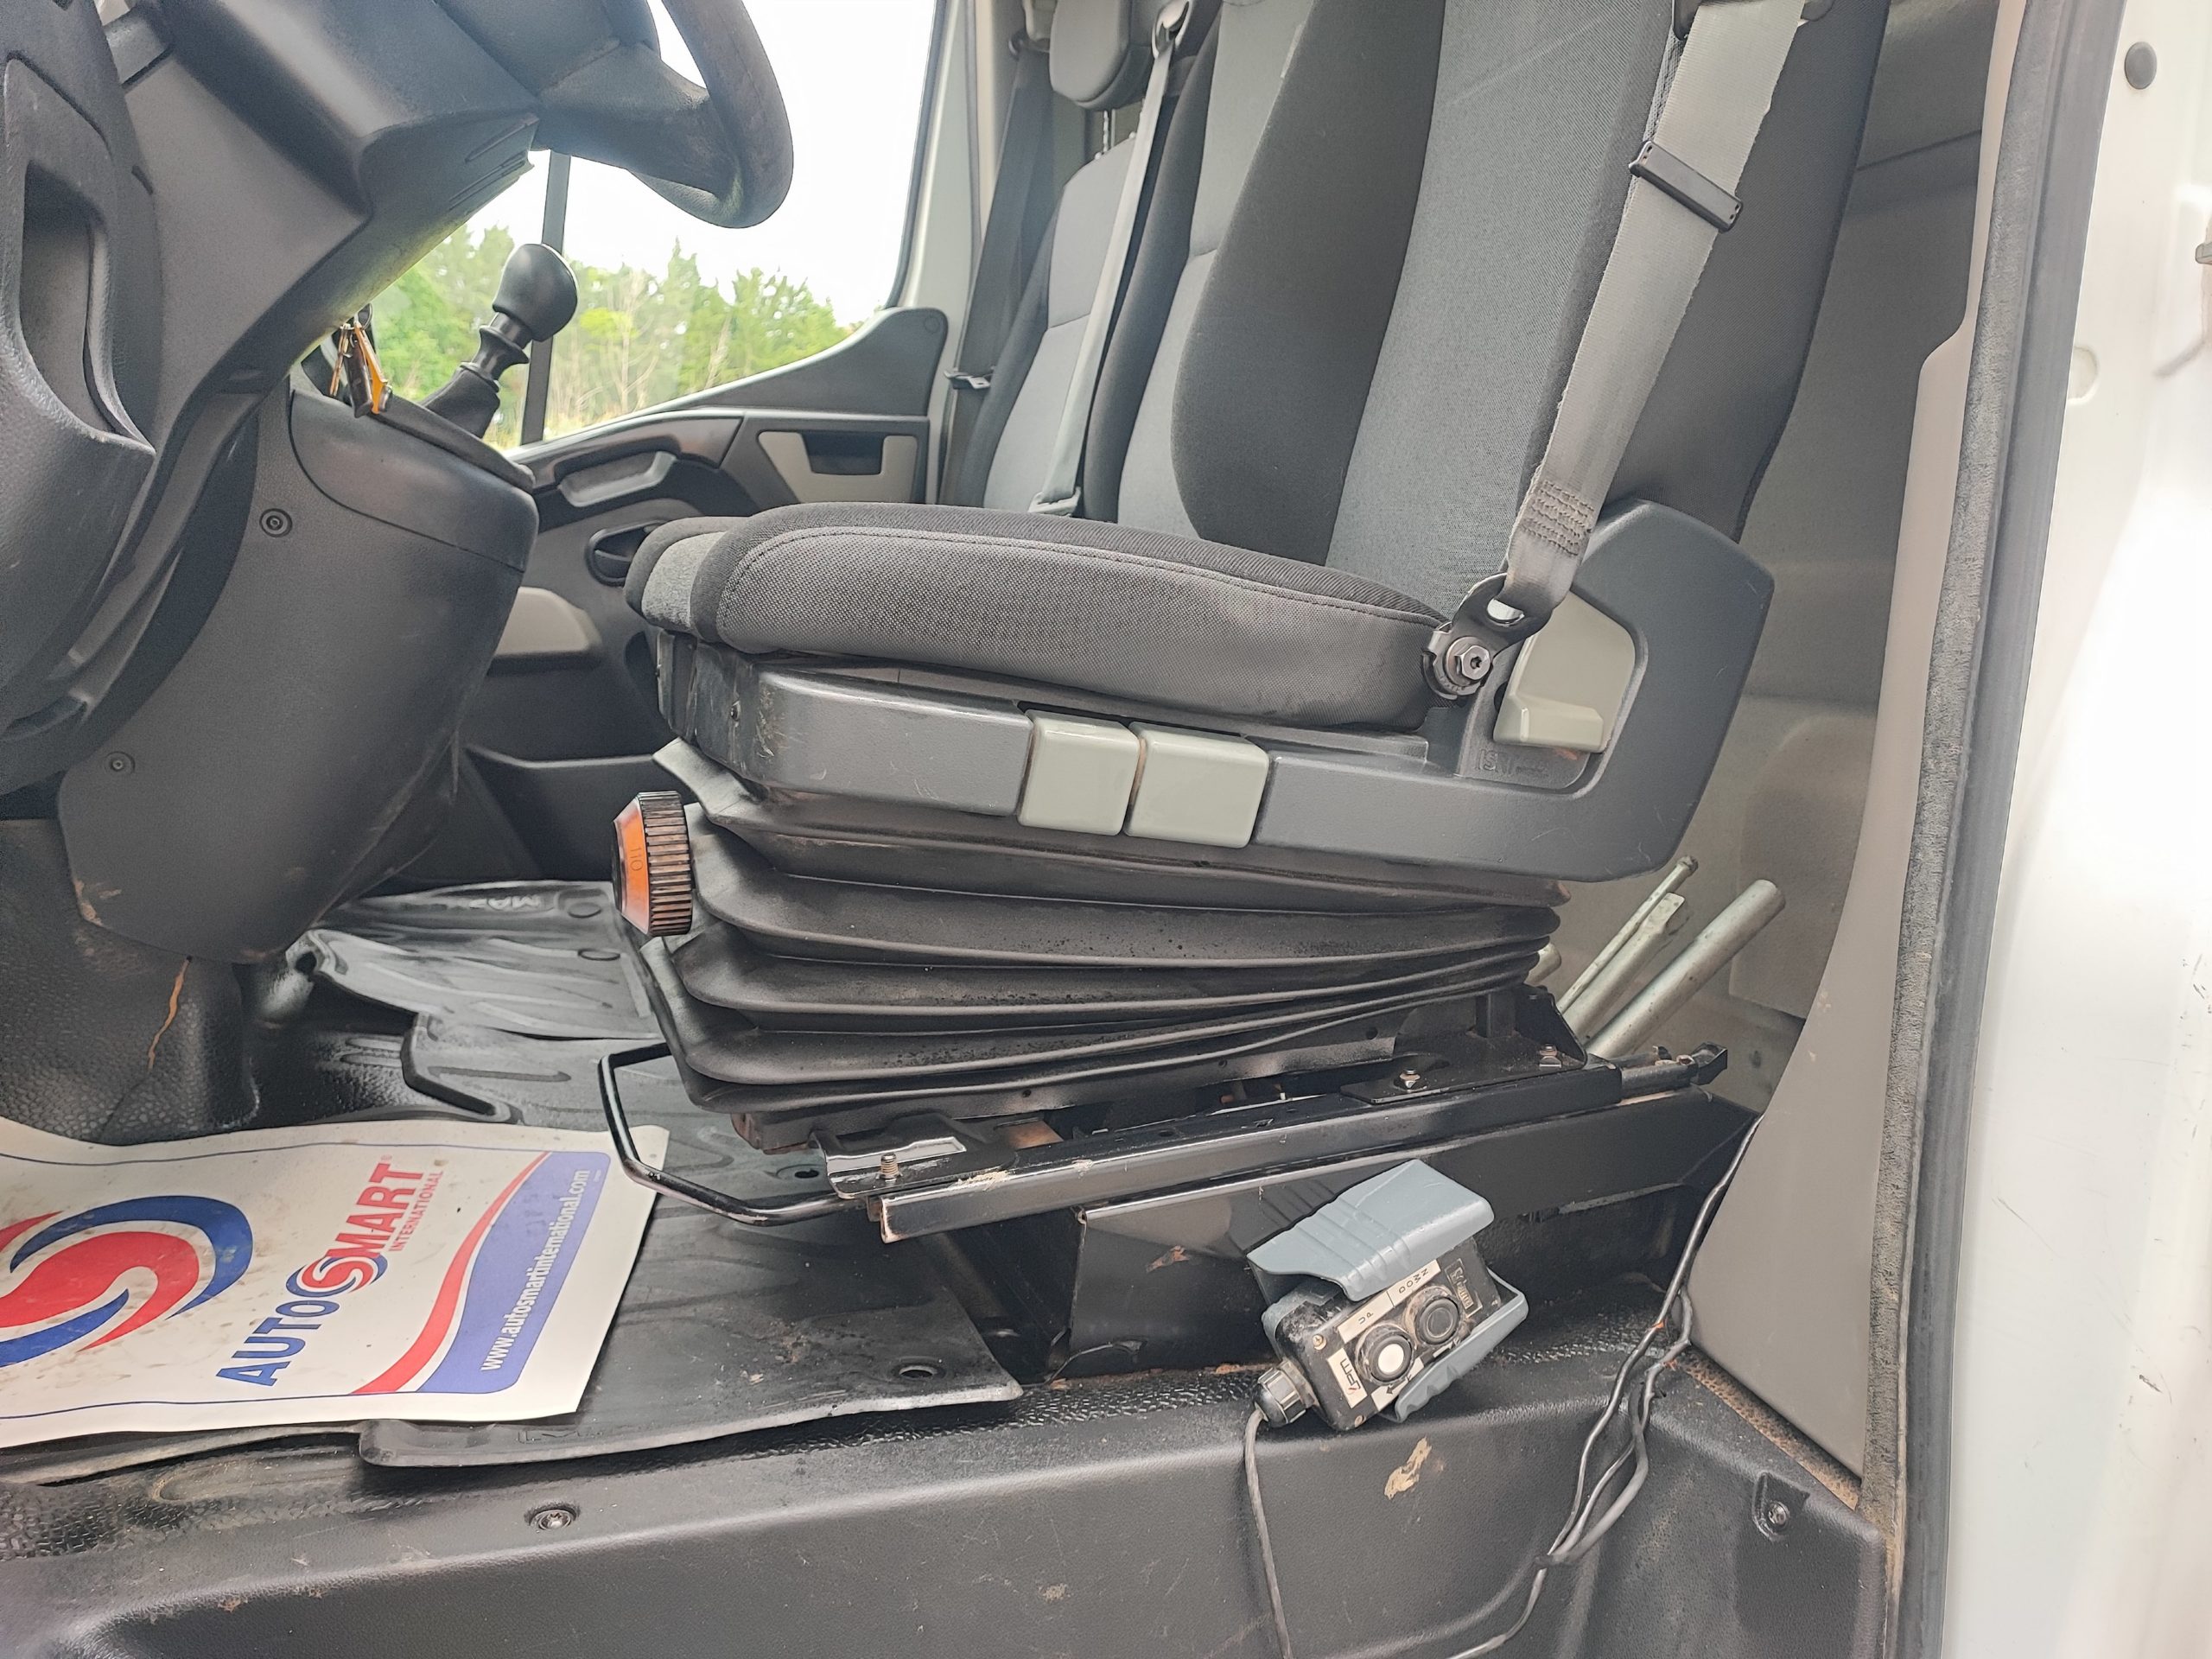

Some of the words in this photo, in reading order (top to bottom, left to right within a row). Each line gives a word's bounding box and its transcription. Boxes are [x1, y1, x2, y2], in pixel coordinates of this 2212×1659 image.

[389, 1170, 444, 1252] INTERNATIONAL
[480, 1169, 590, 1372] www.autosmartinternational.com
[1398, 1268, 1429, 1294] DOWN
[1357, 1311, 1375, 1325] UP
